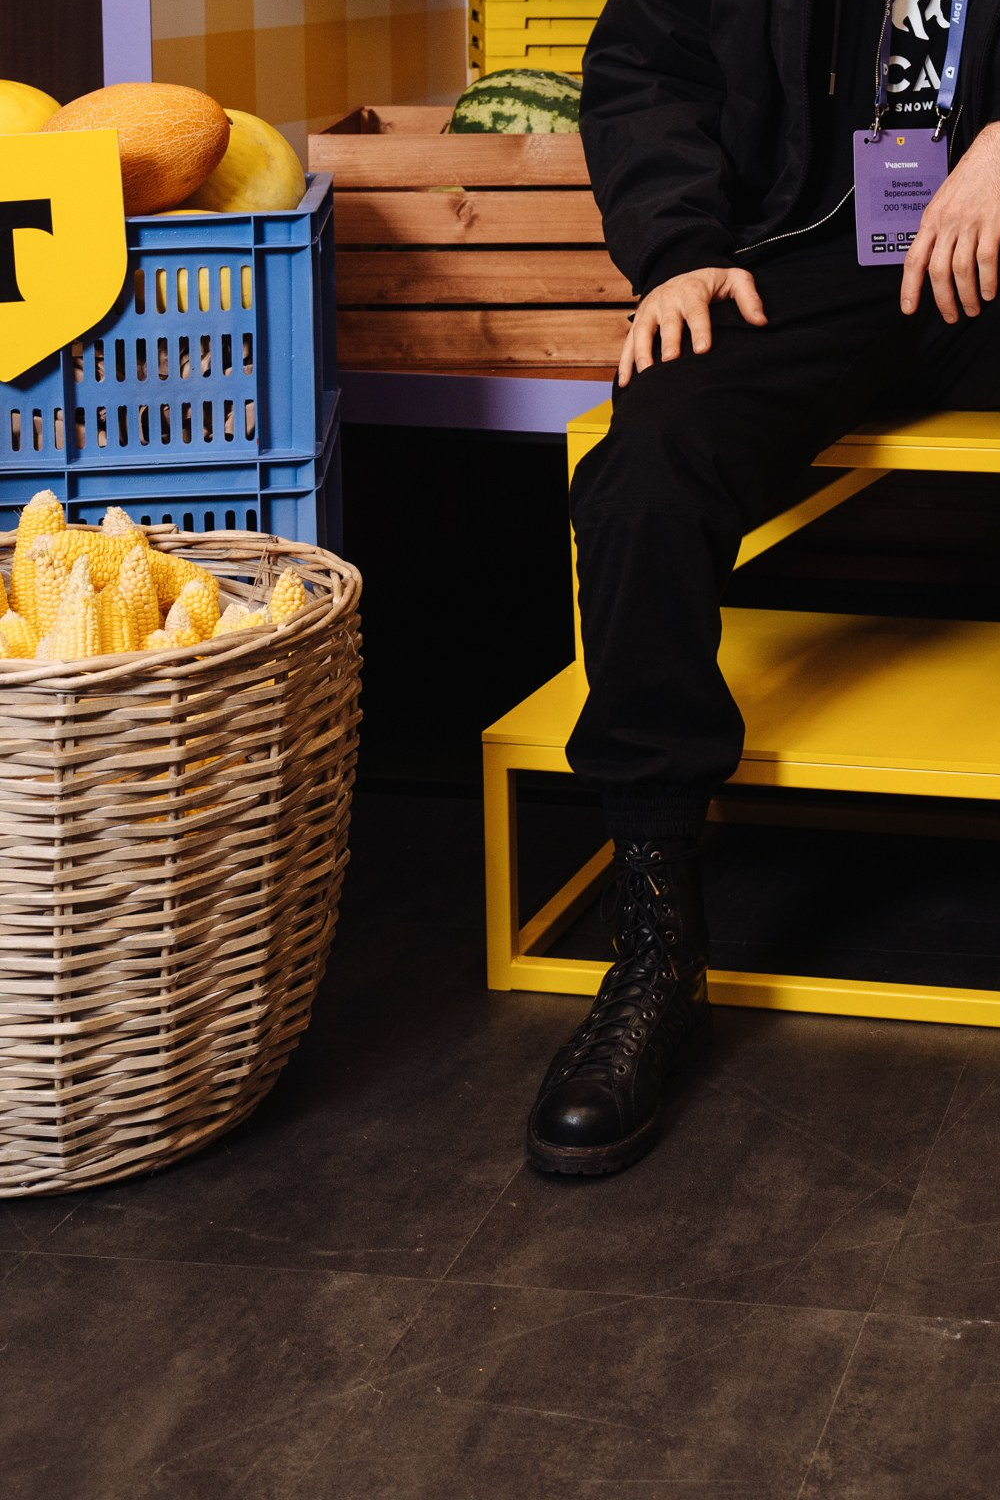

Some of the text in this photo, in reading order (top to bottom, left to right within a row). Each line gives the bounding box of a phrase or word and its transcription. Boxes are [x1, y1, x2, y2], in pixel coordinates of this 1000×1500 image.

[952, 3, 962, 24] Day
[884, 161, 918, 169] Участник
[892, 180, 923, 188] Вячеслав
[884, 203, 900, 211] ООО
